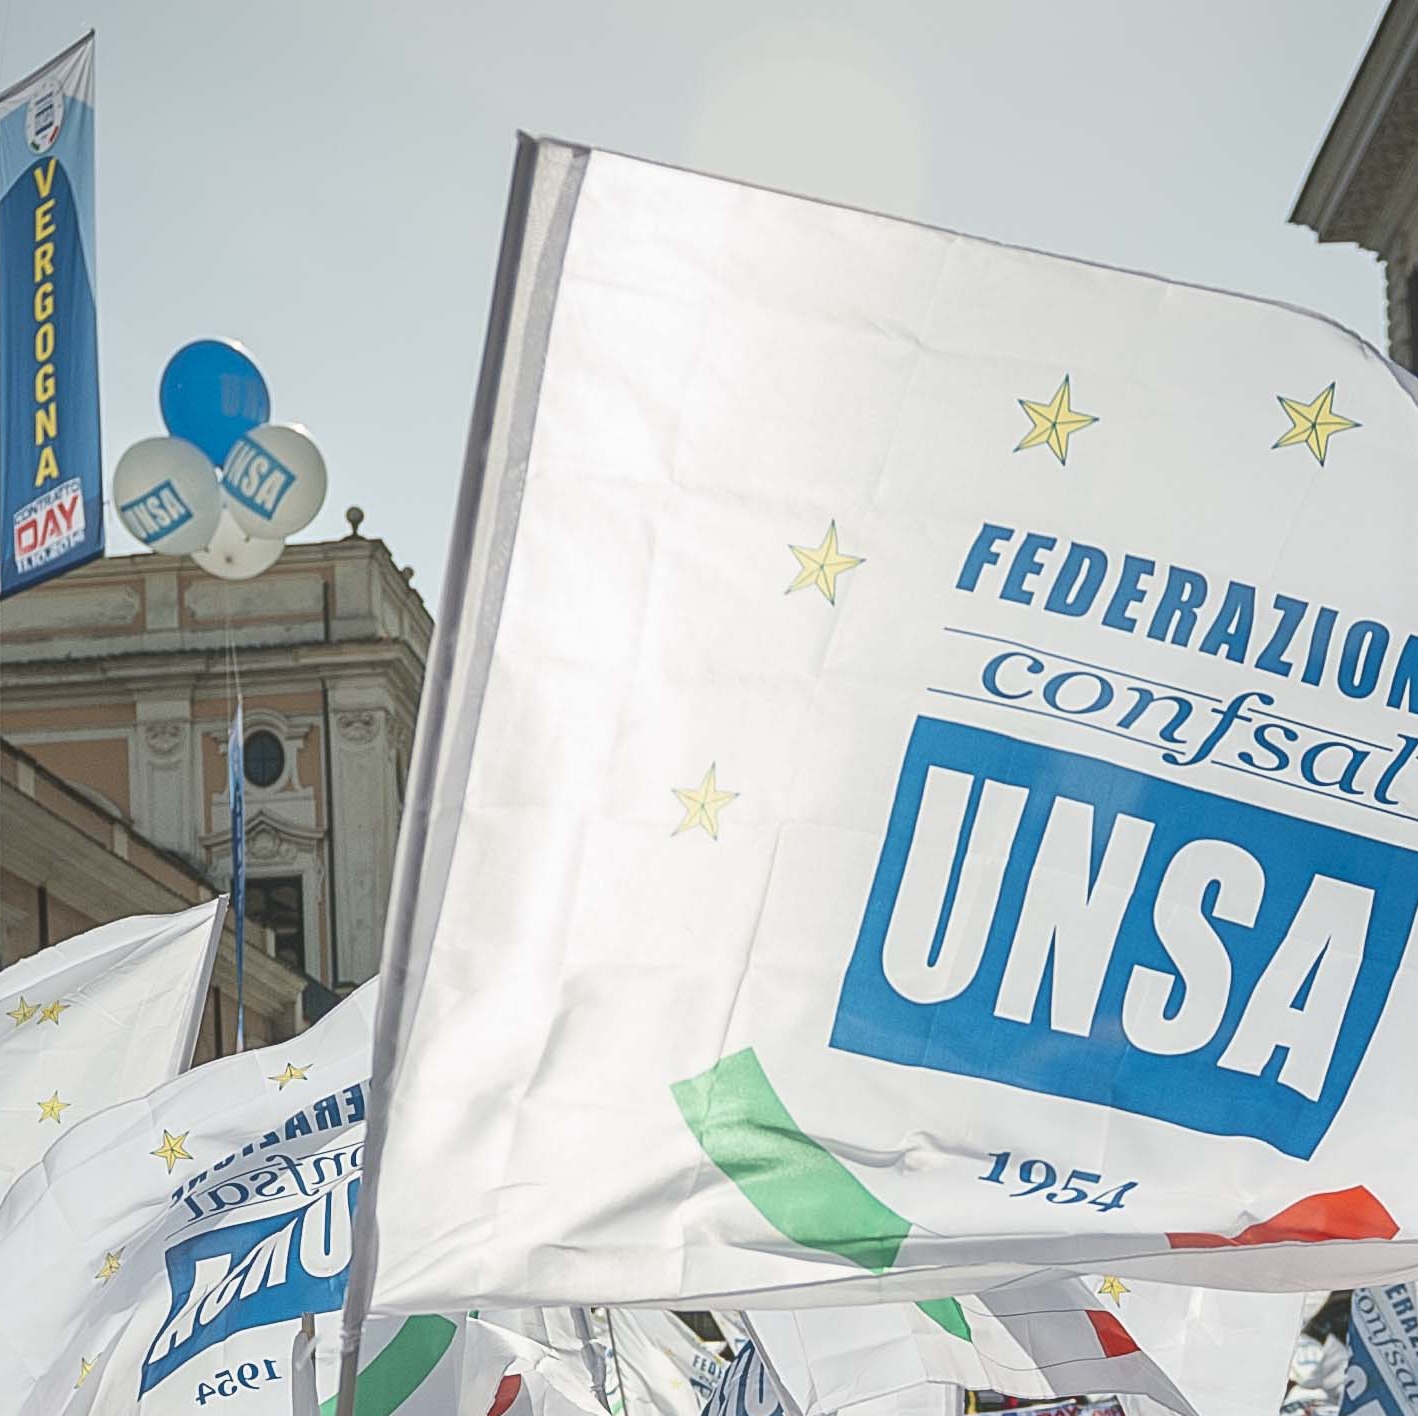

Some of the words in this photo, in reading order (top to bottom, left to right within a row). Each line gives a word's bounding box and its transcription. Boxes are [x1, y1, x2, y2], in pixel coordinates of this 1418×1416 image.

[34, 157, 59, 488] VERGOGNA
[224, 440, 286, 509] NSA
[16, 496, 78, 555] DAY
[881, 764, 1375, 1102] UNSA
[978, 1151, 1137, 1213] 1954
